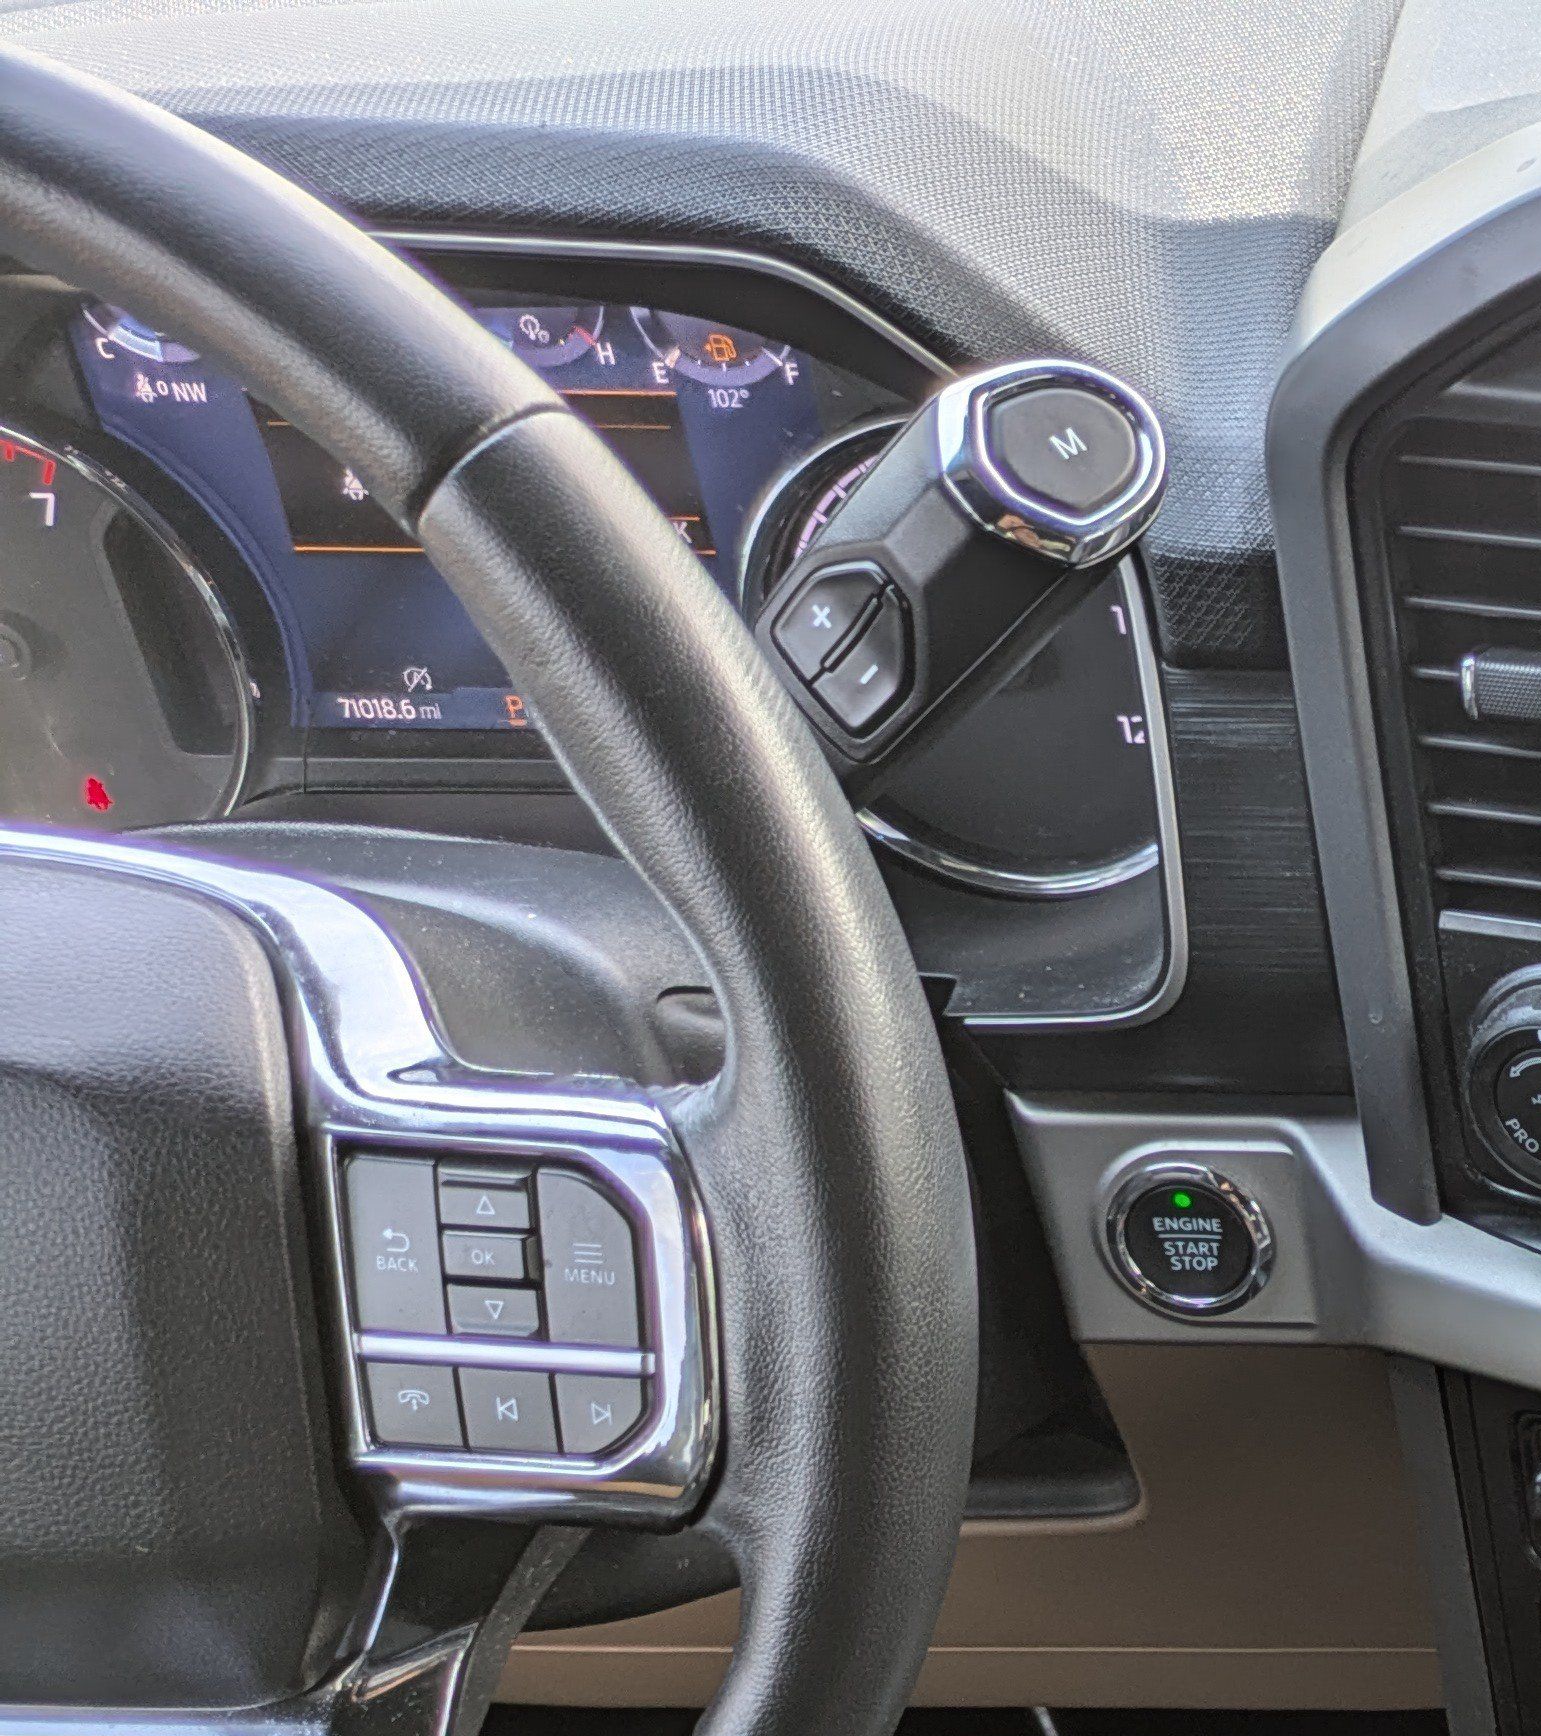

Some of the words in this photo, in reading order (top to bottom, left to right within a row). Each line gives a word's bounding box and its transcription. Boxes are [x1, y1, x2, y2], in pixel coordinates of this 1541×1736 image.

[95, 337, 115, 359] C
[595, 342, 616, 366] H
[652, 362, 670, 385] E
[783, 361, 799, 386] F
[171, 381, 207, 403] NW
[707, 387, 749, 409] 102°
[1048, 427, 1088, 460] M
[29, 492, 55, 526] 7
[337, 698, 416, 720] 71018.6
[419, 703, 442, 720] mi
[1505, 1117, 1540, 1153] PRO
[1152, 1216, 1223, 1233] ENGINE
[471, 1250, 494, 1265] OK
[1163, 1241, 1220, 1256] START
[376, 1257, 418, 1273] BACK
[1170, 1256, 1218, 1272] STOP
[564, 1268, 615, 1285] MENU
